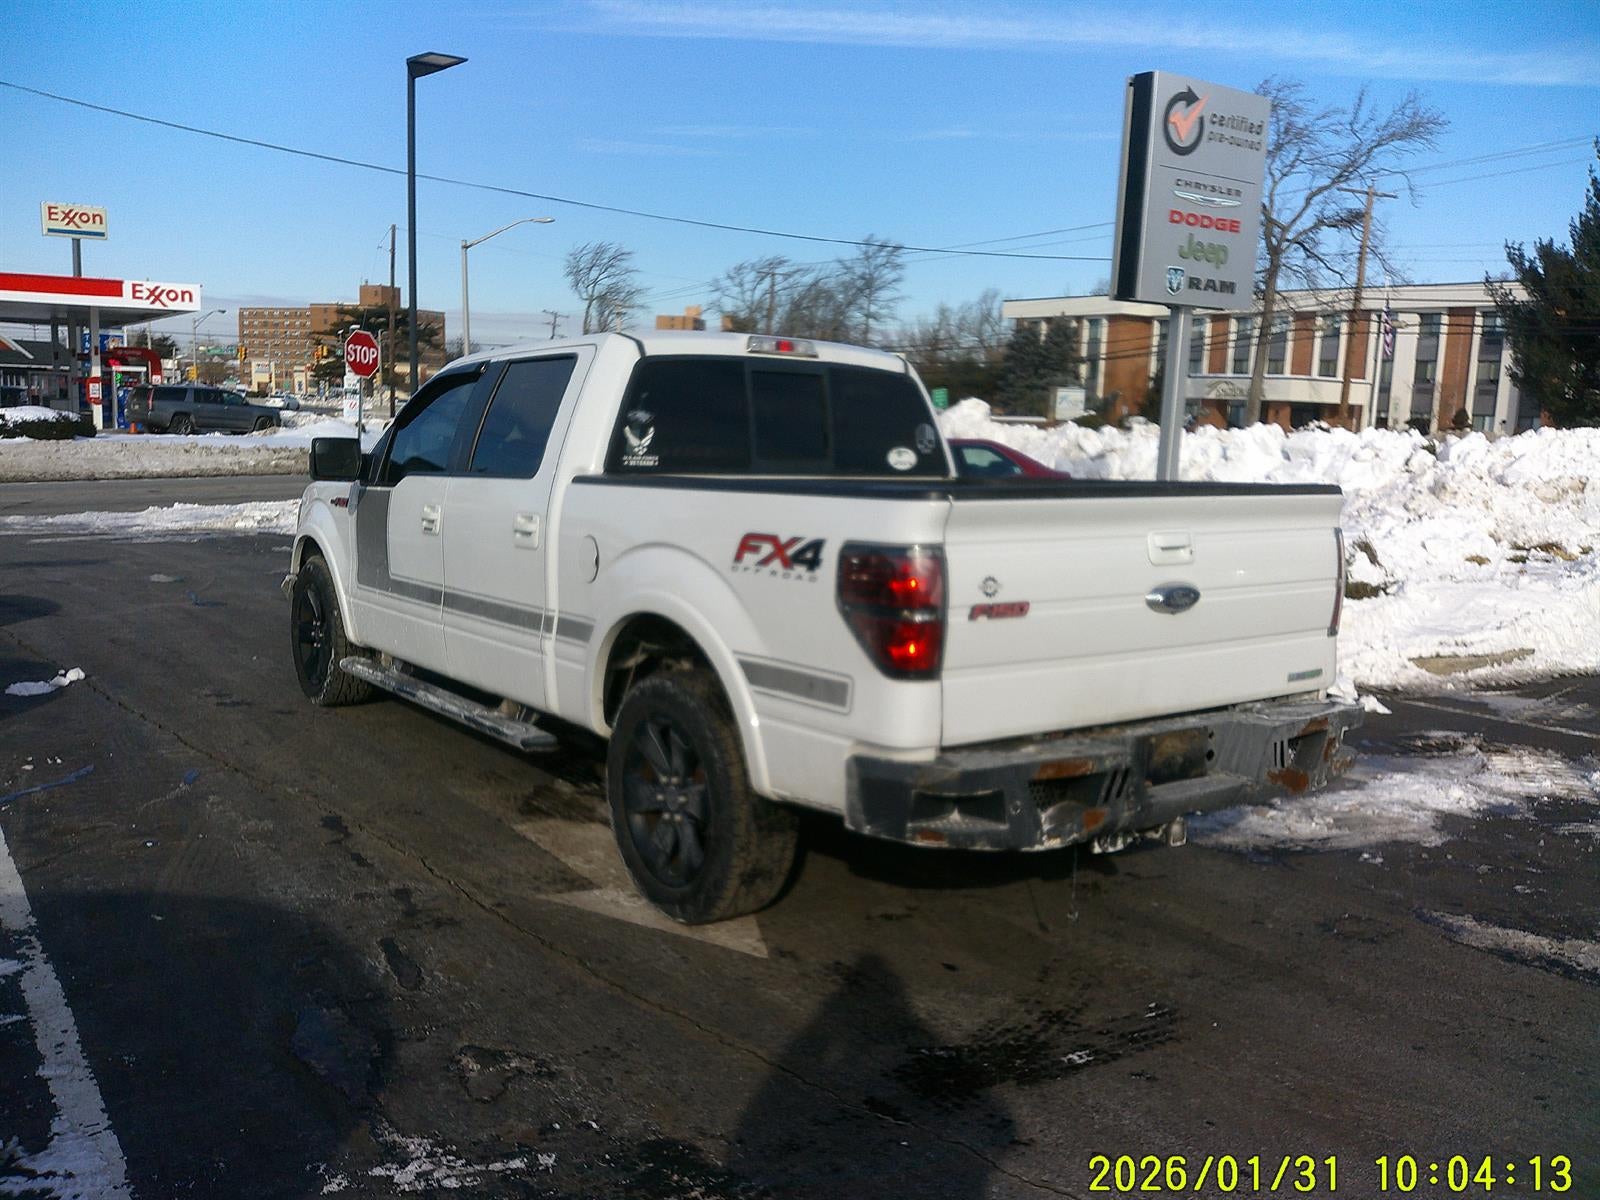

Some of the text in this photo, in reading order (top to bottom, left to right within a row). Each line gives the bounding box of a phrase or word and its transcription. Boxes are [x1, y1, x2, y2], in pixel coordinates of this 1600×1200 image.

[1209, 113, 1264, 135] certified
[1208, 131, 1262, 151] pre-owned
[1175, 178, 1242, 197] CHRYSLER
[47, 206, 104, 229] Exxon
[1169, 209, 1241, 233] DODGE
[1178, 232, 1229, 270] Jeep
[131, 283, 194, 308] Exxon
[1187, 276, 1237, 295] RAM
[347, 343, 378, 365] STOP
[733, 532, 827, 572] FX4
